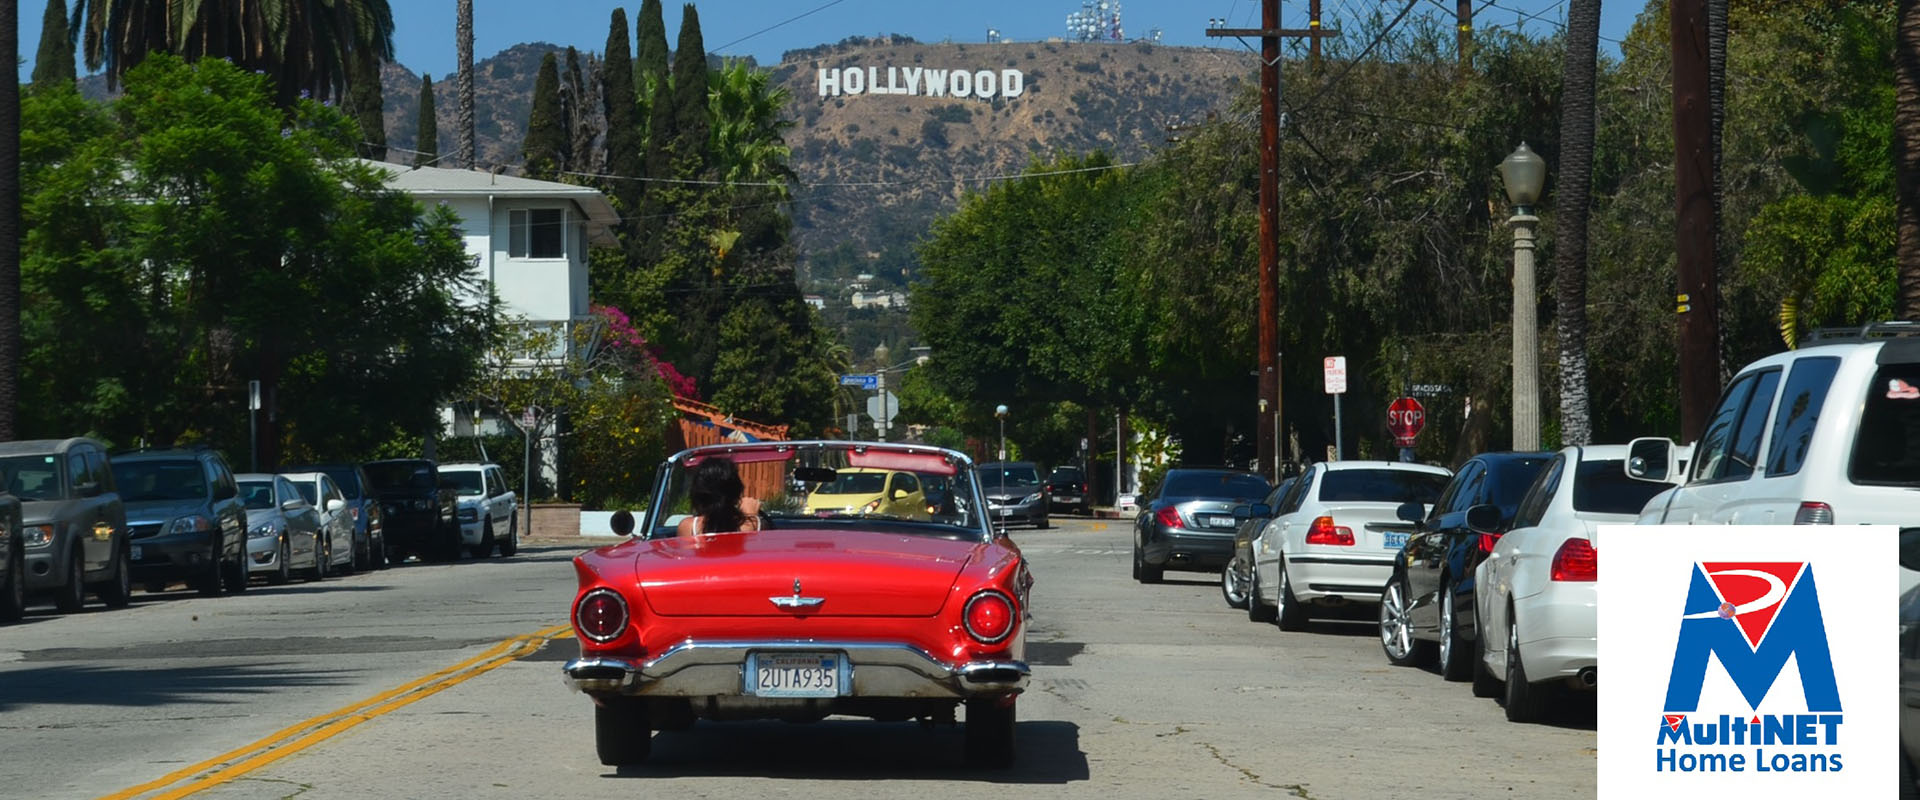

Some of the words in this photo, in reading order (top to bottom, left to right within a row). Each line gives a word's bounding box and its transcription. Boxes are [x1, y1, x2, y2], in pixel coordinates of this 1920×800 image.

[818, 66, 1024, 98] HOLLYWOOD
[1389, 410, 1422, 426] STOP
[761, 668, 833, 688] 2UTA935
